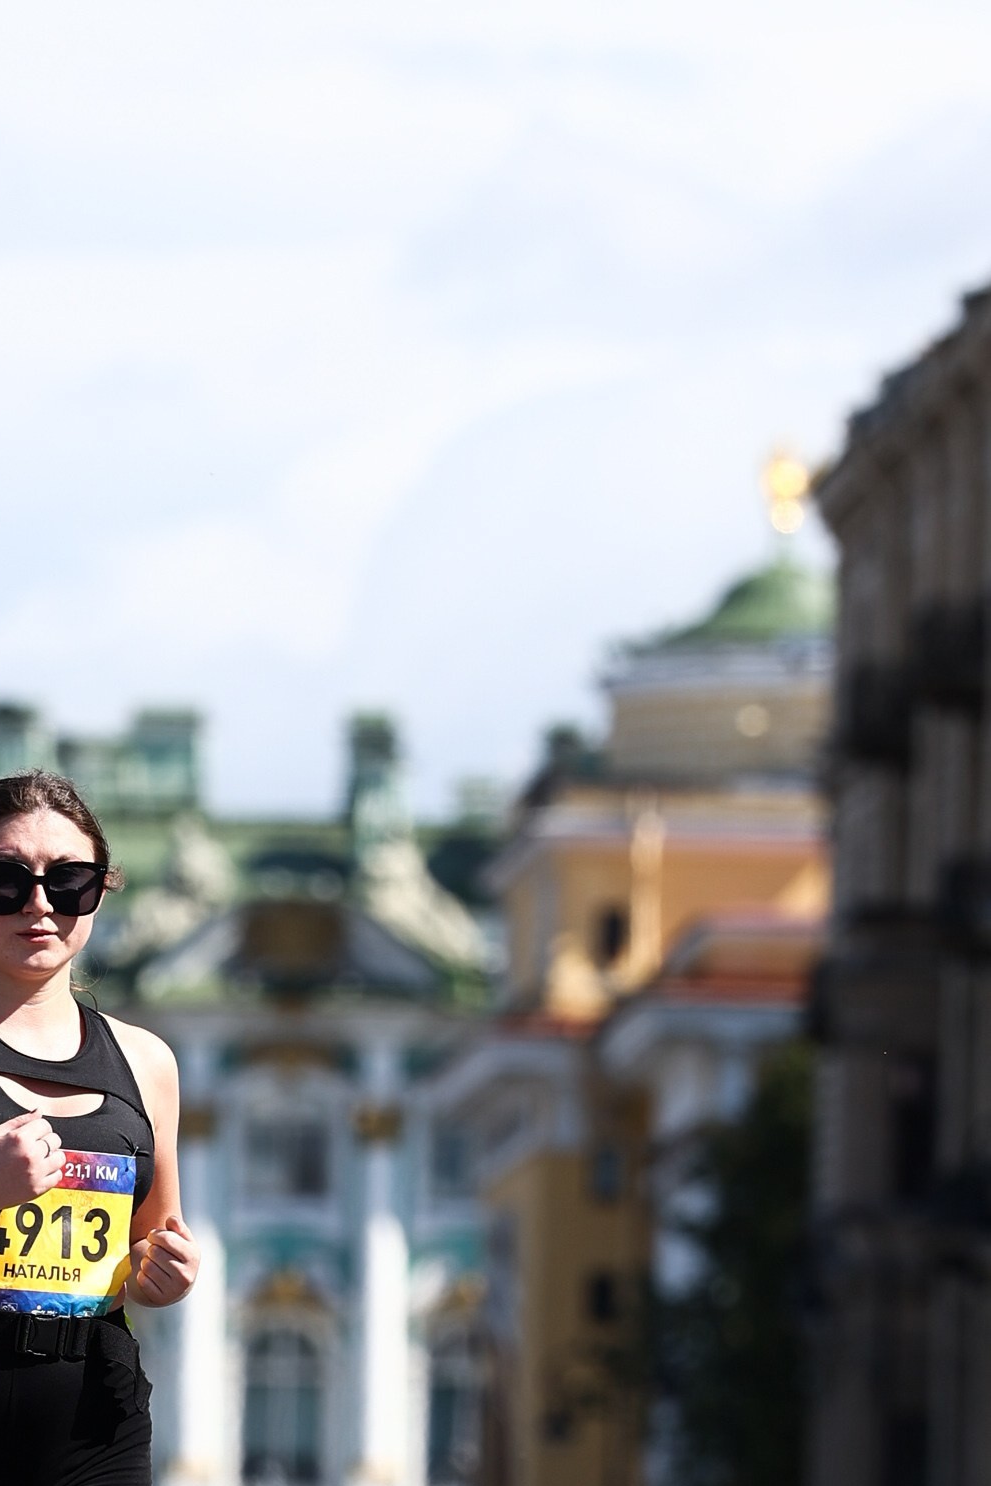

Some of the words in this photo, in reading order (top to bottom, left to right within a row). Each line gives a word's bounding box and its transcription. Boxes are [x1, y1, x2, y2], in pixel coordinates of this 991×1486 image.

[65, 1163, 91, 1180] 21,1
[95, 1165, 118, 1181] КМ
[3, 1263, 81, 1282] НАТАЛЬЯ
